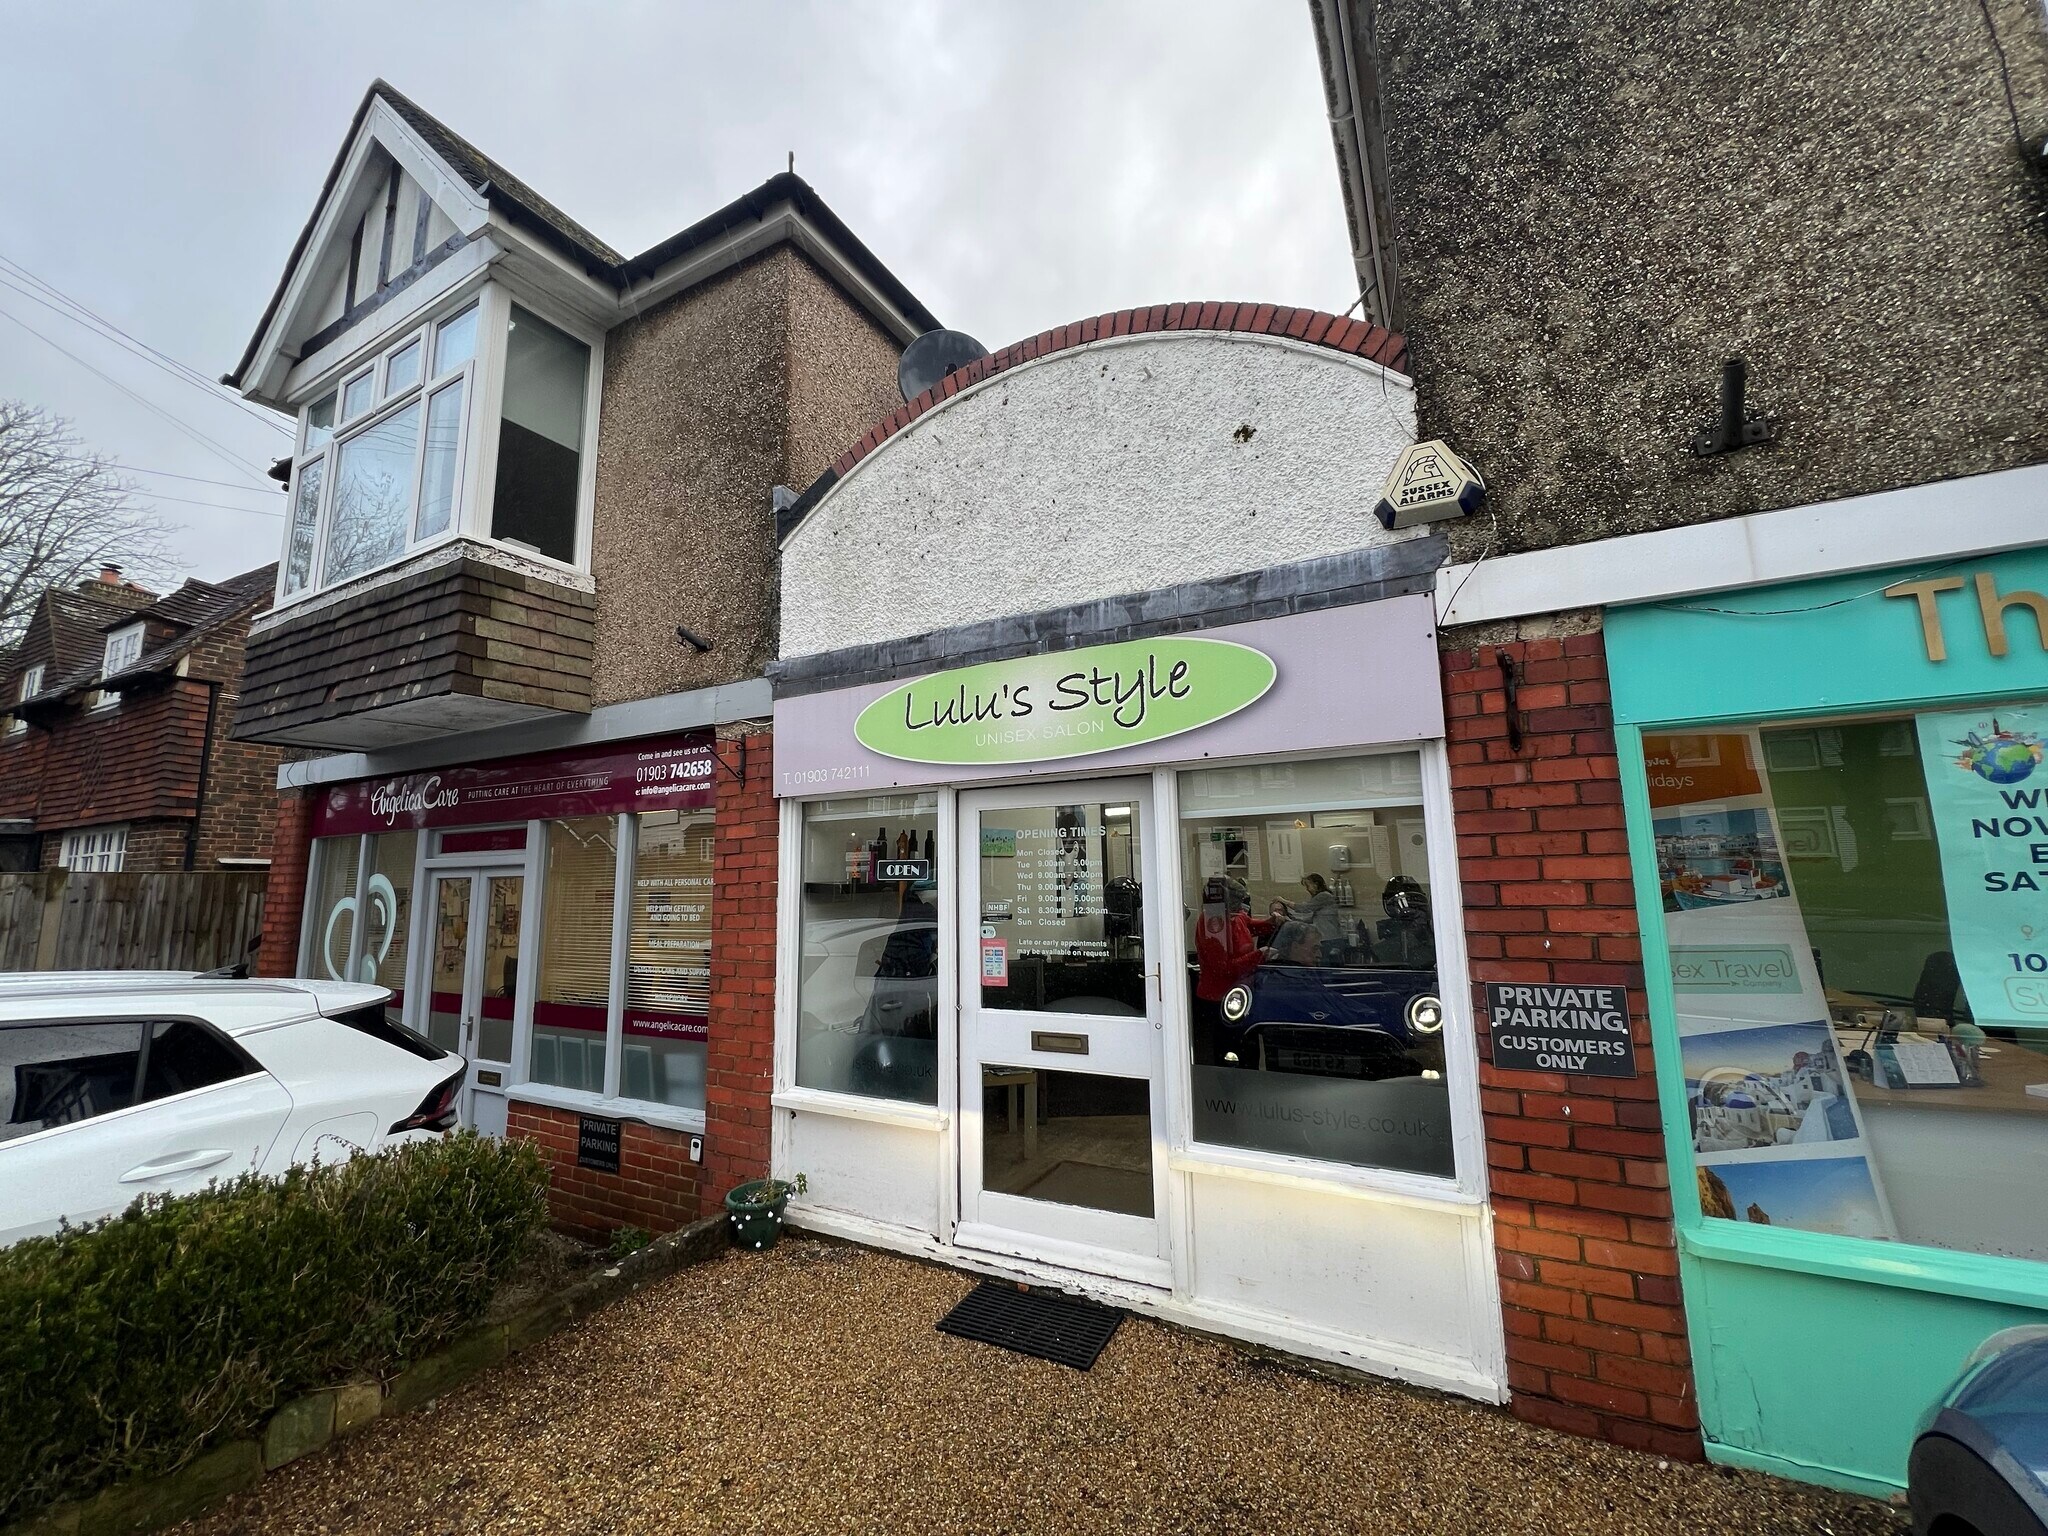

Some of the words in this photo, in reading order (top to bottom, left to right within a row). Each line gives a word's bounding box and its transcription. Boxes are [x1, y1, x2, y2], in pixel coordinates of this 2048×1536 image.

[1402, 480, 1450, 496] SUSSEX
[1400, 488, 1454, 505] ALARMS
[906, 684, 1033, 729] Lulu's
[1049, 654, 1190, 727] Style
[975, 729, 1036, 746] UNISEX
[1043, 720, 1104, 739] SALON
[655, 751, 660, 759] in
[661, 749, 671, 758] and
[673, 749, 683, 757] see
[1644, 757, 1671, 767] yJet
[636, 765, 667, 782] 01903
[670, 760, 712, 778] 742658
[795, 769, 827, 784] 01903
[831, 765, 870, 780] 742111
[468, 788, 492, 799] PUTTING
[494, 787, 509, 797] CARE
[511, 786, 519, 795] AT
[520, 784, 531, 794] THE
[534, 782, 553, 793] HEART
[556, 781, 565, 790] OF
[567, 776, 609, 789] EVERYTHING
[641, 782, 711, 795] info@angelicacare.com
[1999, 788, 2048, 810] W
[1016, 828, 1067, 839] OPENING
[1070, 825, 1106, 837] TIMES
[1038, 848, 1065, 856] Closed
[886, 864, 920, 876] OPEN
[1073, 859, 1103, 868] 5.00pm
[674, 878, 702, 886] PERSONAL
[1074, 871, 1103, 880] 5.00pm
[1074, 883, 1103, 891] 5.00pm
[1074, 895, 1103, 903] 5.00pm
[1074, 907, 1108, 915] 12.30pm
[1038, 918, 1066, 926] Closed
[664, 940, 700, 948] PREPARATION
[1043, 939, 1059, 947] early
[1708, 959, 1793, 978] Travel
[1498, 986, 1614, 1009] PRIVATE
[1494, 1007, 1624, 1031] PARKING
[633, 1020, 709, 1033] www.angelicacare.com
[1500, 1035, 1625, 1056] CUSTOMERS
[1536, 1053, 1588, 1070] ONLY
[583, 1120, 617, 1135] PRIVATE
[581, 1137, 617, 1153] PARKING
